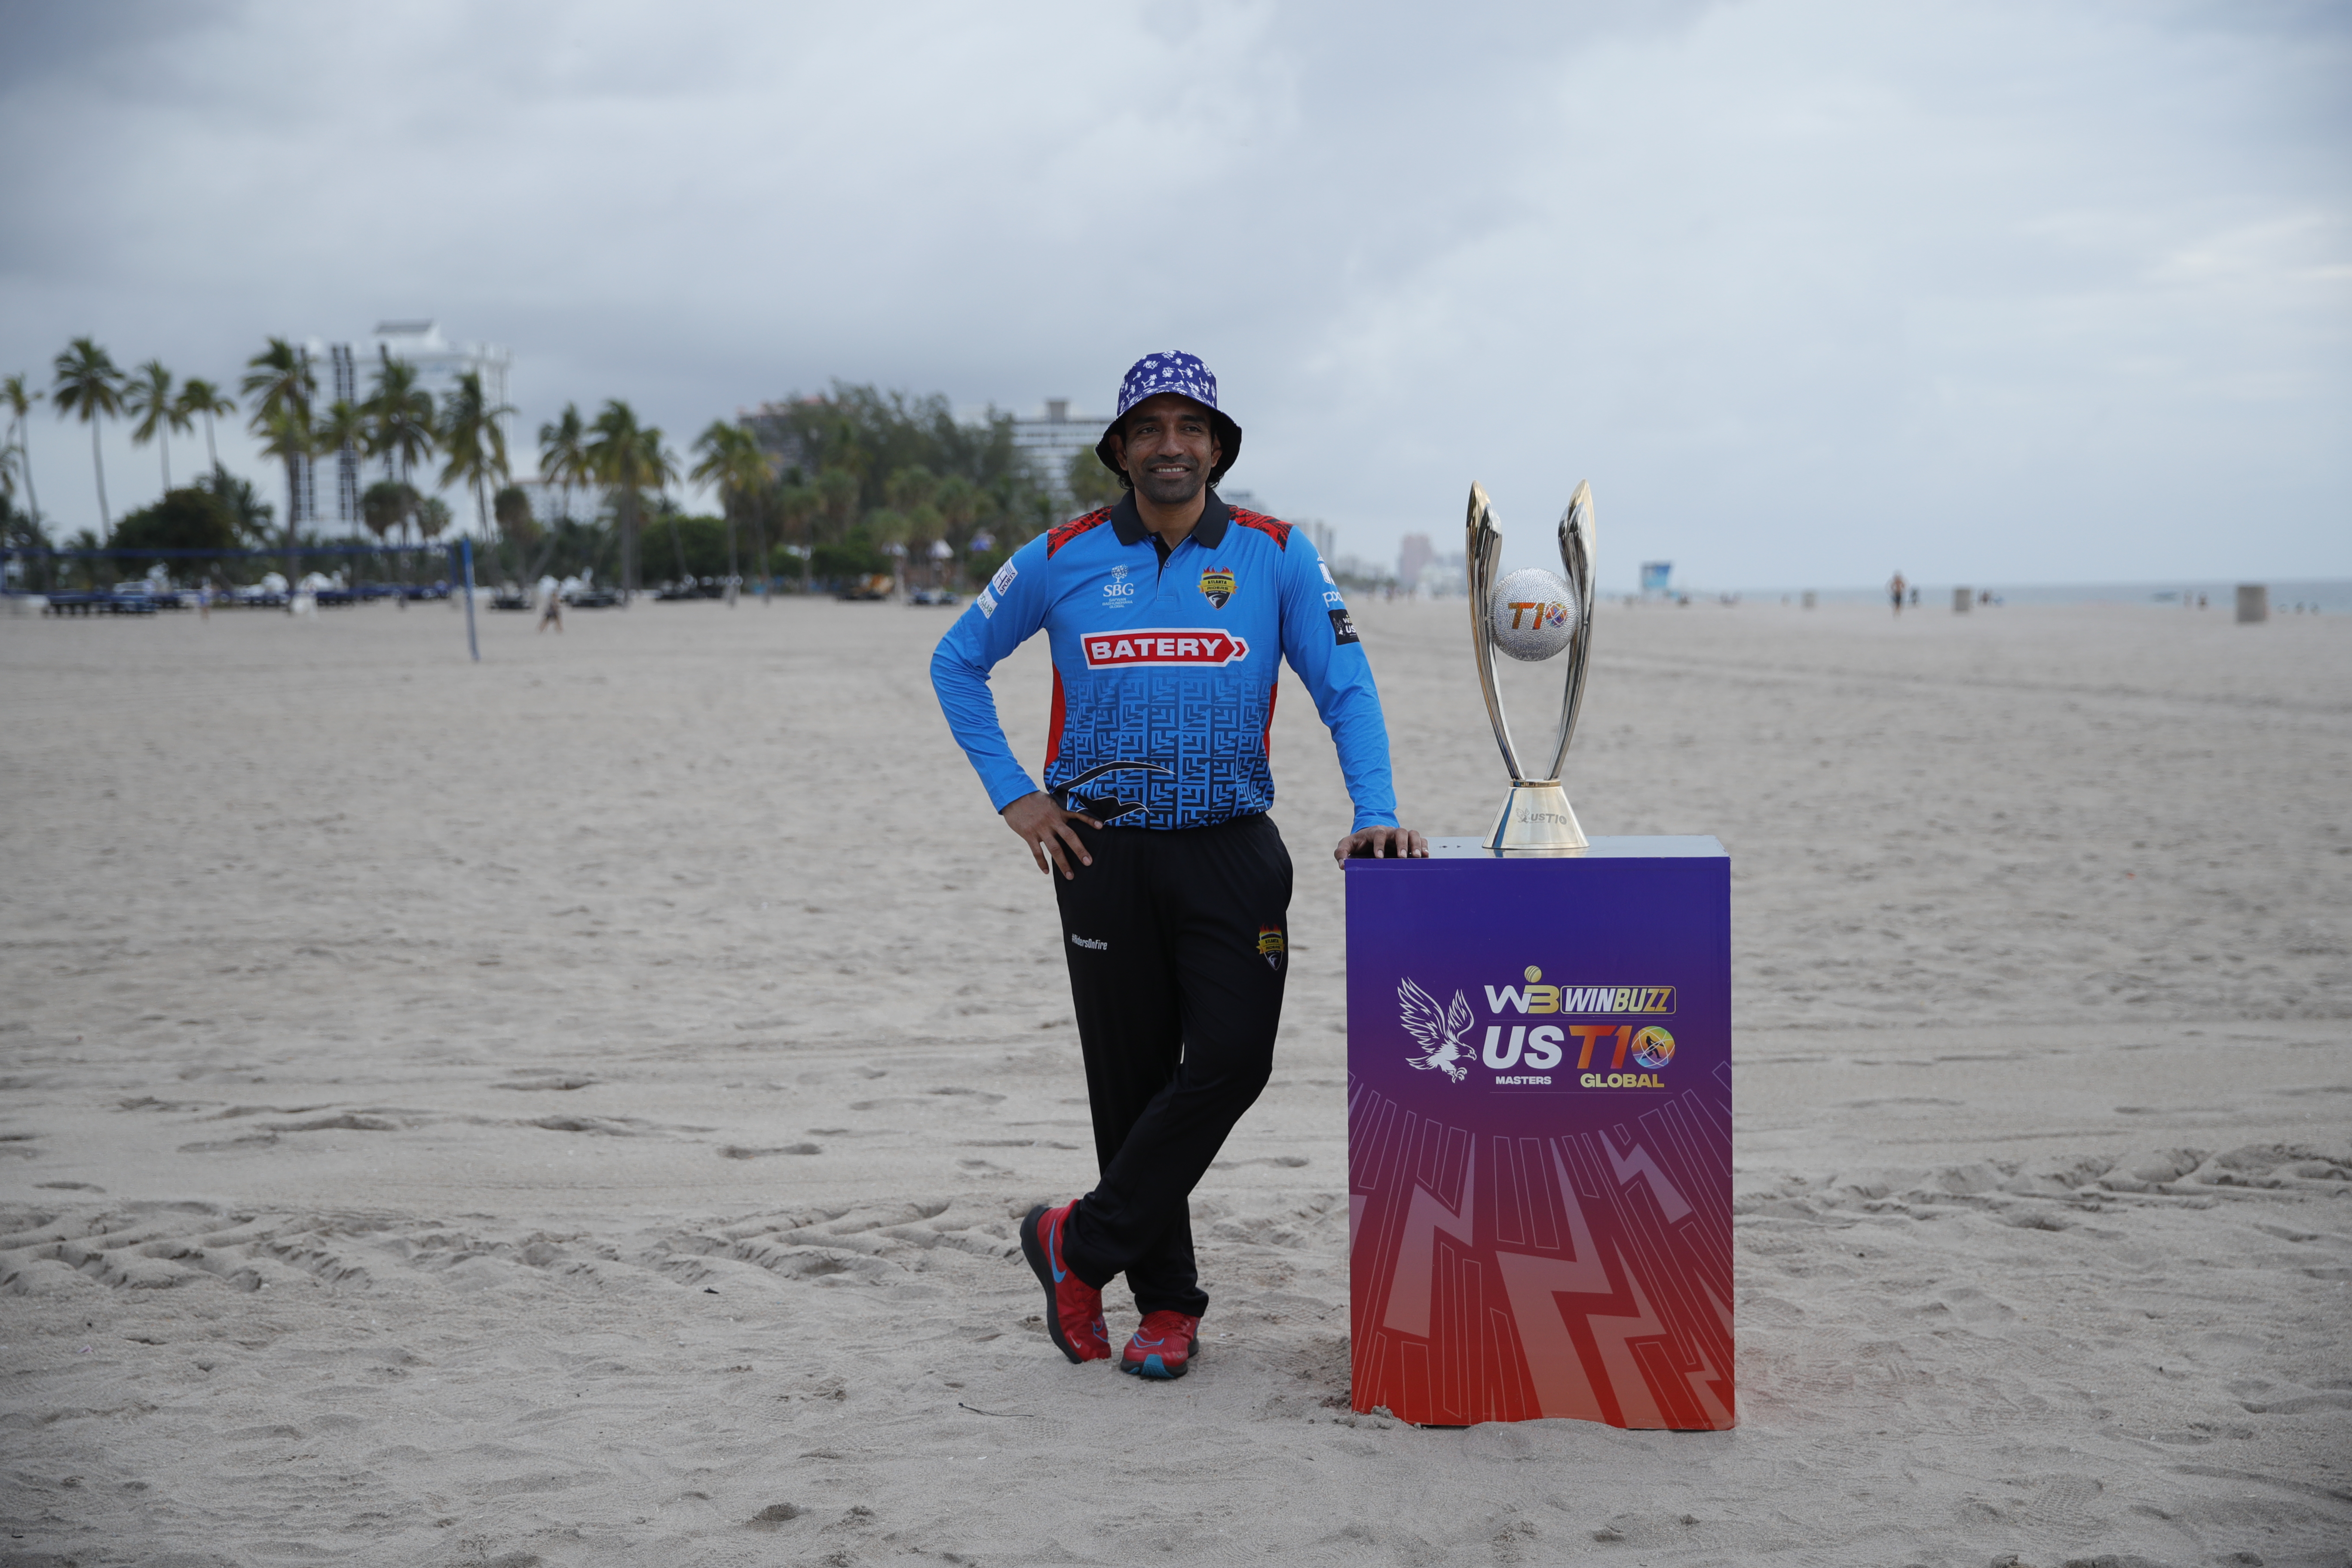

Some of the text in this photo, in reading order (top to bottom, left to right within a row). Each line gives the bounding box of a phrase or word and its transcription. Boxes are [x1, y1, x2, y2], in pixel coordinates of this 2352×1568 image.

[1000, 571, 1016, 594] SPORTS
[1103, 583, 1134, 597] SBG
[980, 593, 992, 615] DOLLAR
[1091, 638, 1222, 660] BATERY
[1565, 988, 1672, 1012] WINBUZZ
[1496, 1076, 1552, 1084] MASTERS
[1580, 1073, 1664, 1088] GLOBAL
